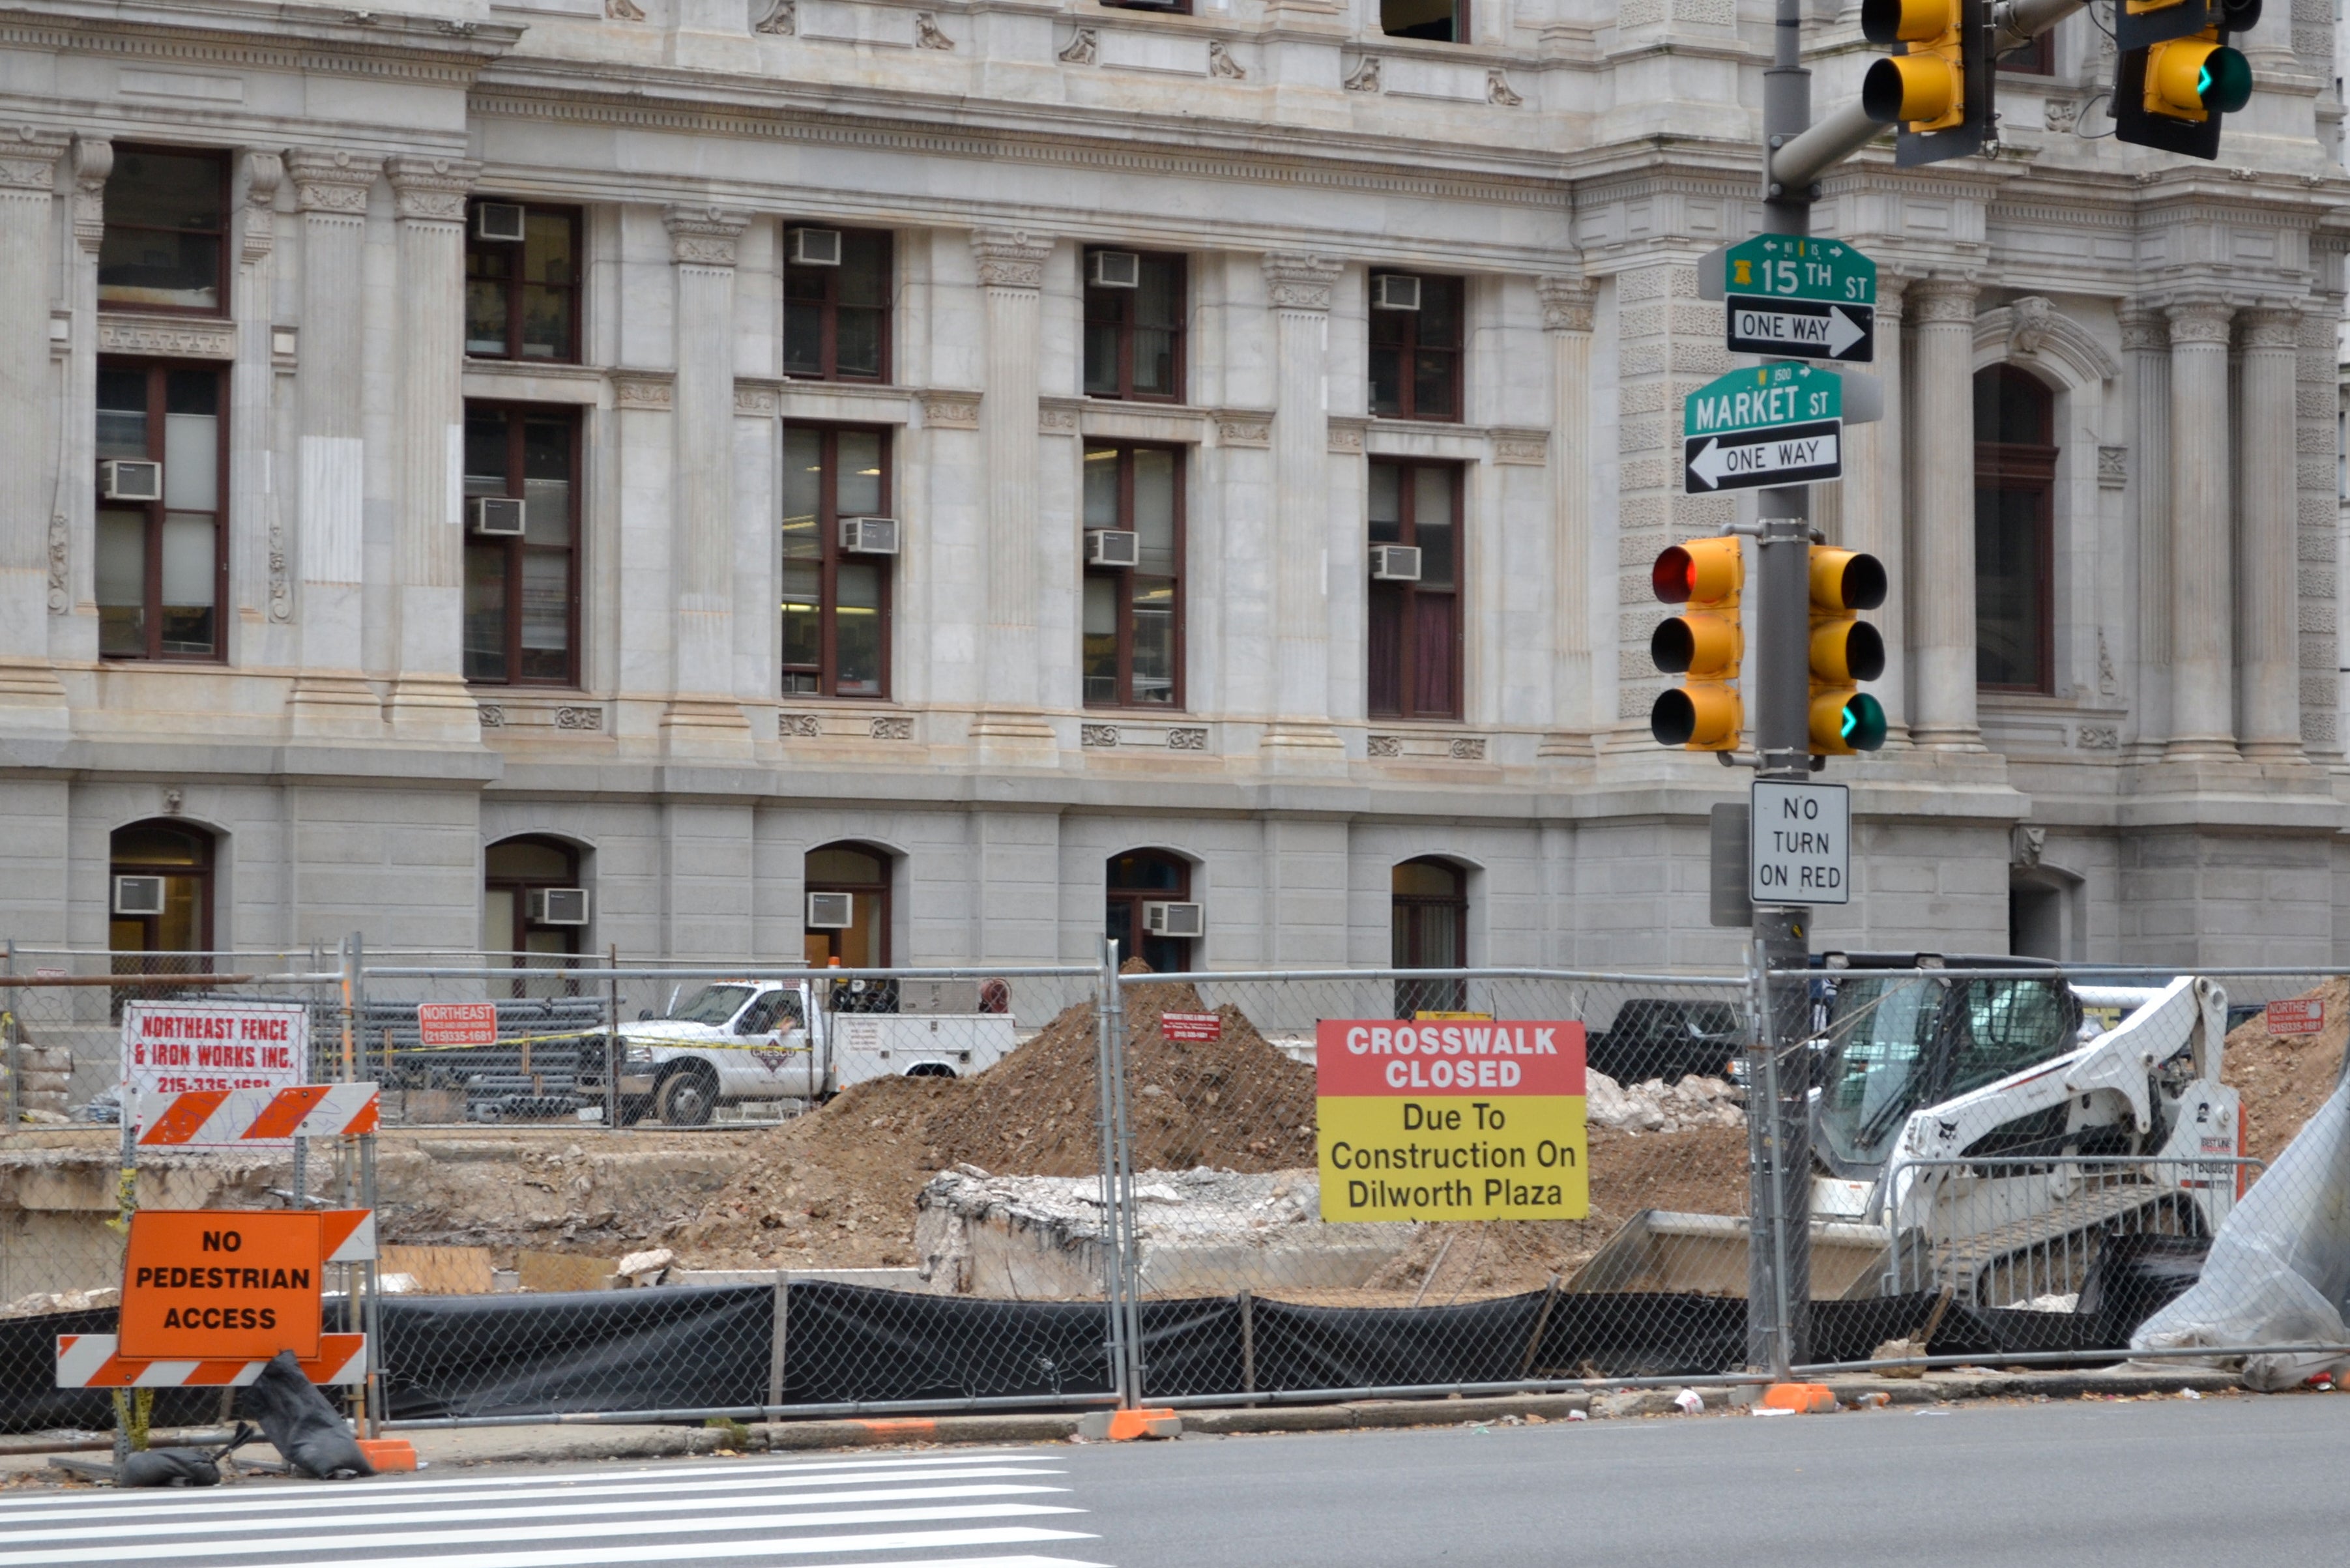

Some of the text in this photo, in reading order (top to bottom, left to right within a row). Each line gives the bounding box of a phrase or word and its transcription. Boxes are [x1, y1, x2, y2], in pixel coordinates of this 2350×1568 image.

[1845, 276, 1868, 300] ST
[1743, 314, 1831, 341] ONE WAY
[1696, 385, 1829, 431] MARKET ST
[1727, 440, 1820, 472] ONE WAY
[1784, 798, 1818, 820] NO
[1773, 831, 1829, 854] TURN
[1760, 864, 1841, 888] ON RED
[423, 1006, 492, 1020] NORTHEAST
[2269, 1000, 2322, 1014] NORTHEA
[142, 1016, 288, 1041] NORTHEAST FENCE
[424, 1030, 492, 1043] (215)335-1681
[1346, 1026, 1558, 1055] CROSSWALK
[135, 1043, 294, 1069] & IRON WORKS INC.
[1385, 1060, 1521, 1088] CLOSED
[1404, 1103, 1506, 1131] Due To
[1331, 1140, 1575, 1170] Construction On
[1348, 1179, 1562, 1208] Dilworth Plaza
[202, 1230, 242, 1252] NO
[136, 1267, 310, 1289] PEDESTRIAN
[164, 1308, 277, 1329] ACCESS
